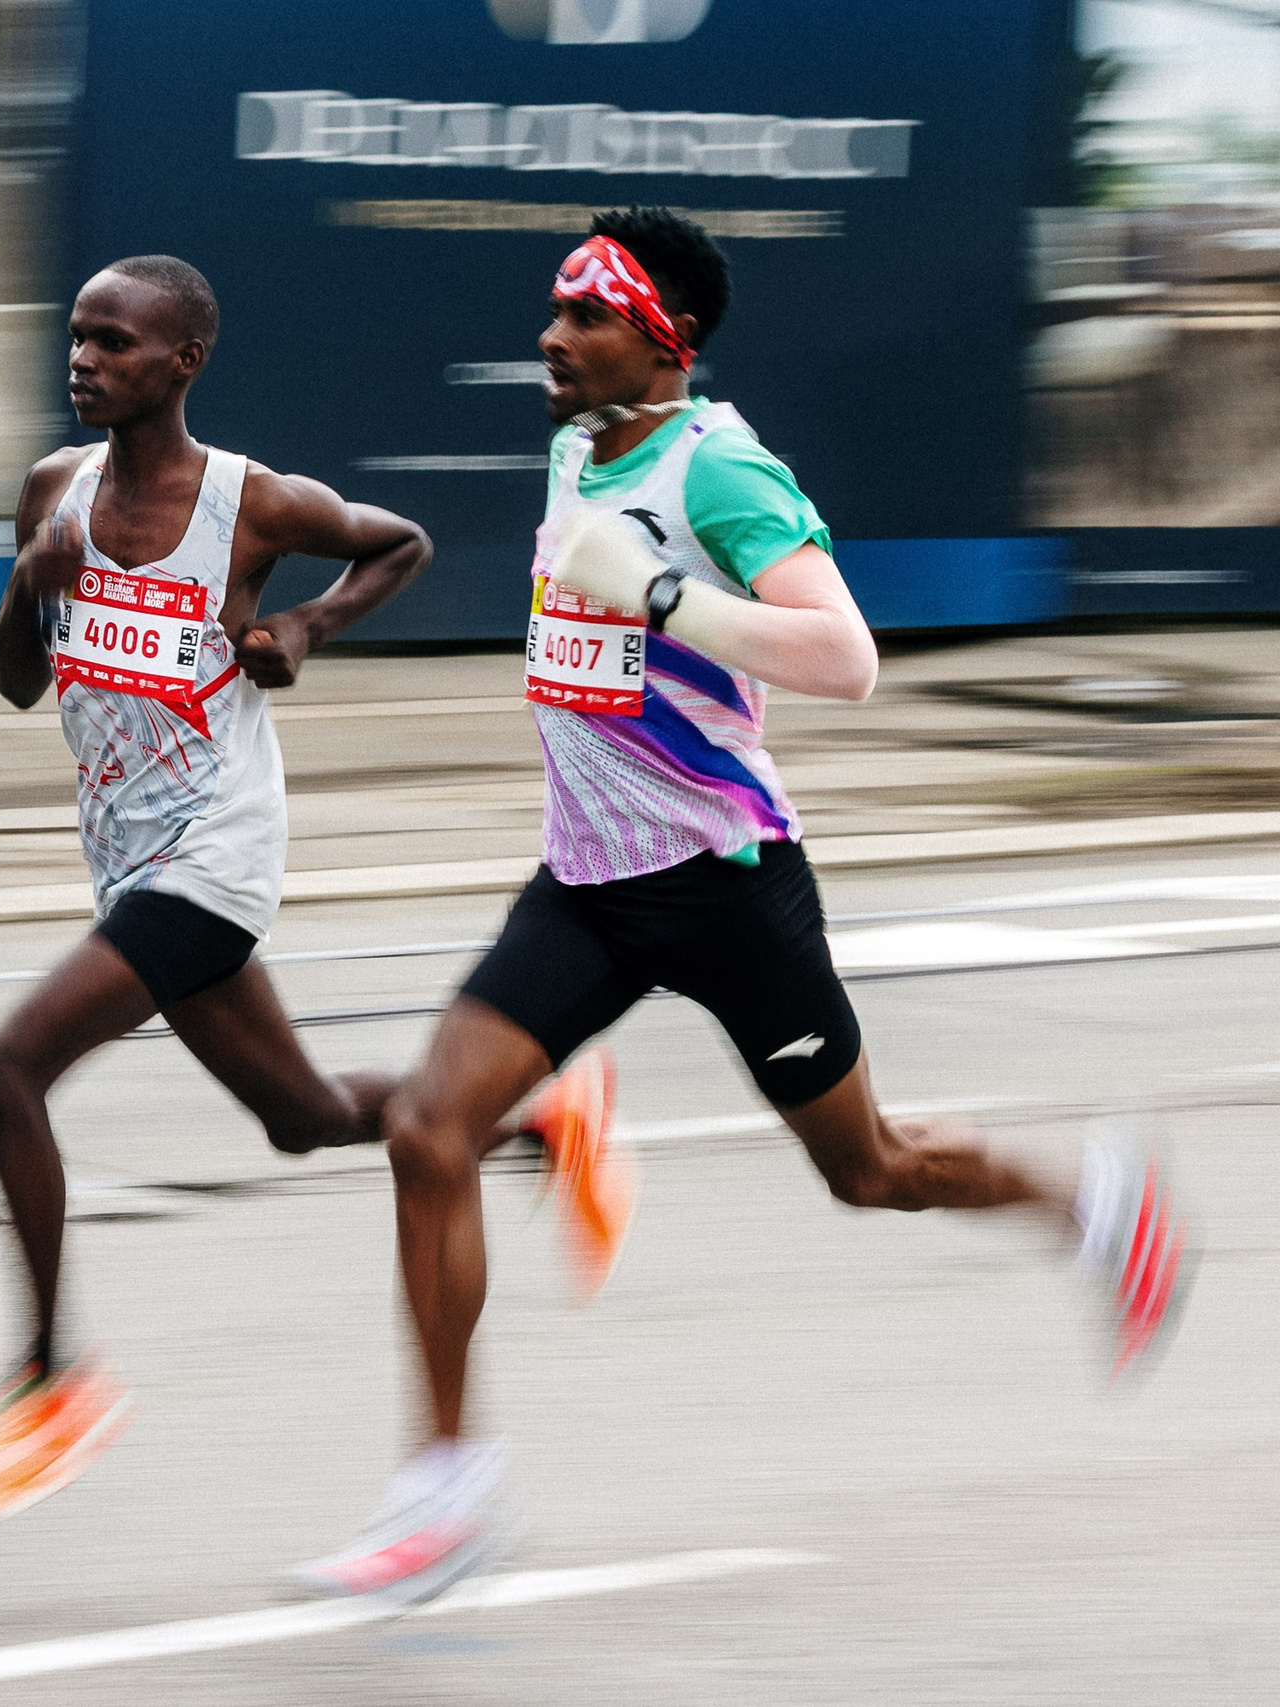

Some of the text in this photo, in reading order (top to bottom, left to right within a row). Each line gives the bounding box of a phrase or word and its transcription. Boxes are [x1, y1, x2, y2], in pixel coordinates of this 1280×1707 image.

[103, 581, 136, 596] BELGRADE
[145, 589, 176, 602] ALWAYS
[102, 590, 138, 605] MARATHON
[143, 597, 166, 609] MORE
[181, 595, 191, 605] 21
[180, 604, 195, 613] KM
[84, 617, 161, 659] 4006
[545, 632, 605, 671] 4007
